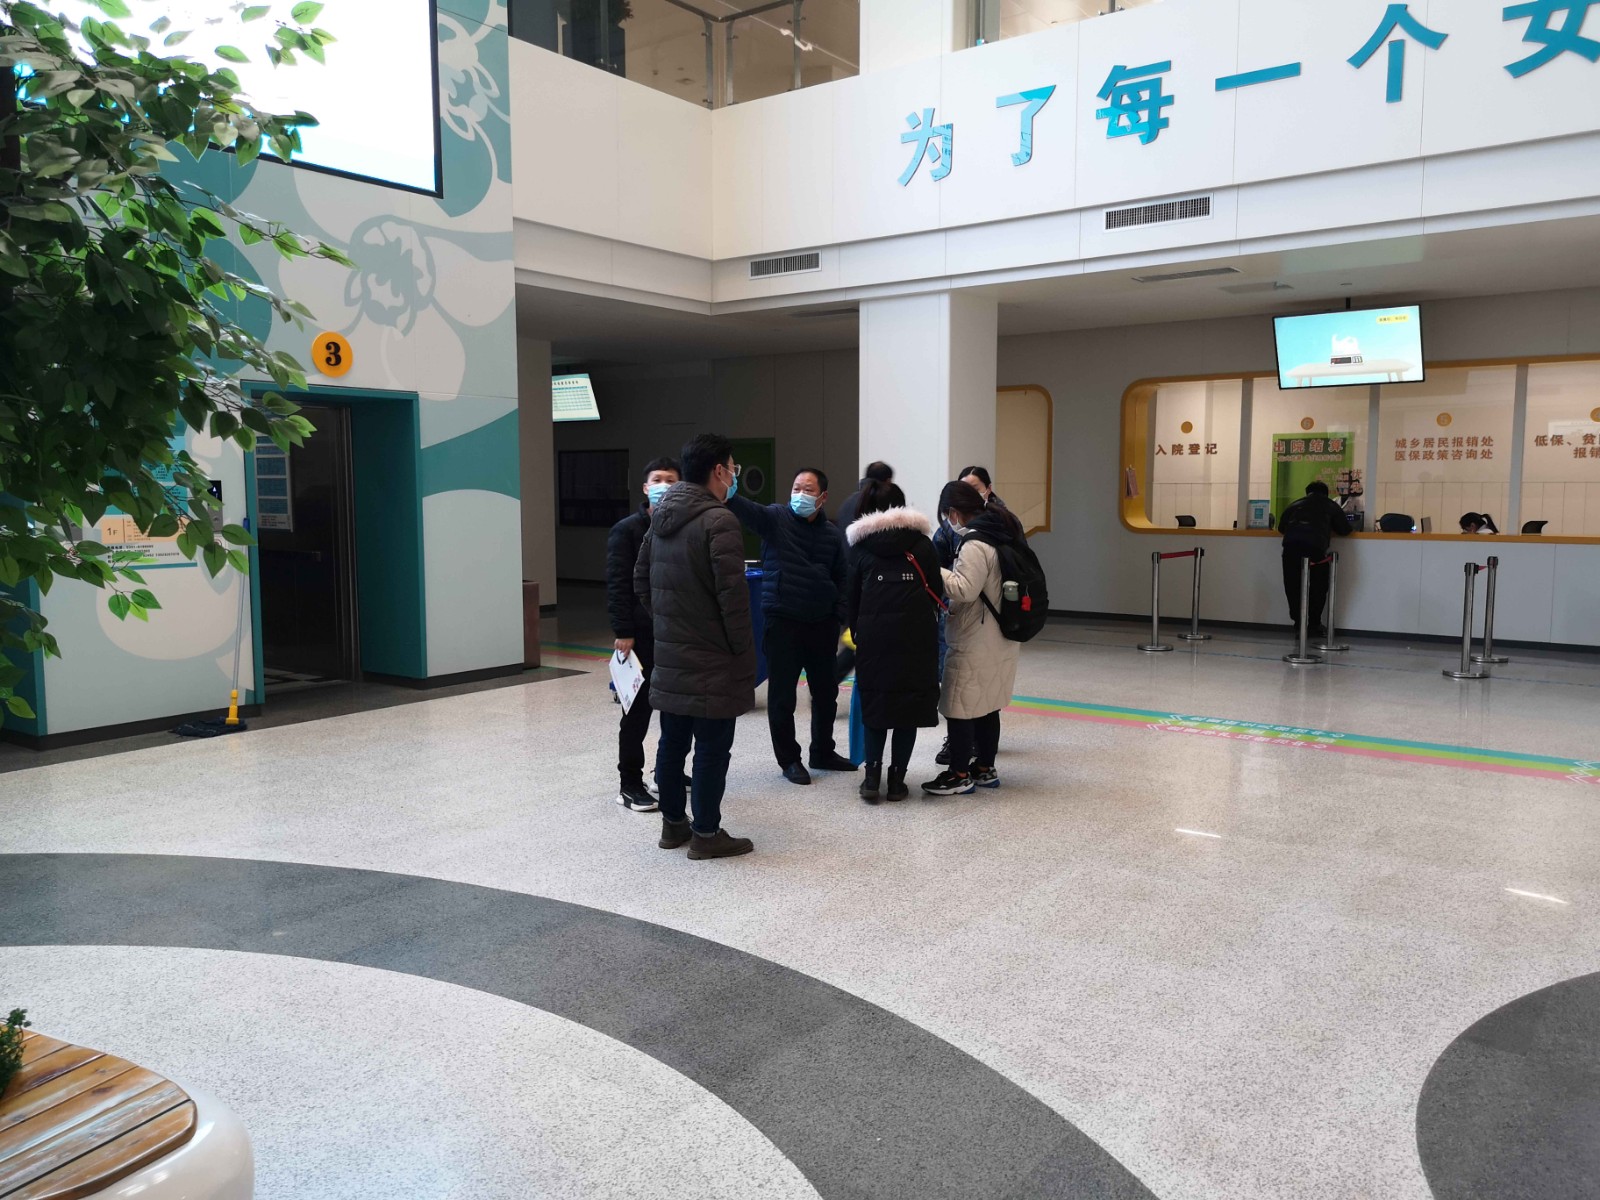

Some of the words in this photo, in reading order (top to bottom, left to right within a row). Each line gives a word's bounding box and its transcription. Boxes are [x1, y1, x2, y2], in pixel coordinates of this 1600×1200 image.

[325, 341, 342, 367] 3
[1155, 443, 1218, 456] 入院登记
[1273, 438, 1344, 454] 出院结算
[1395, 436, 1494, 449] 城乡居民报销处
[1394, 448, 1493, 462] 医保政策咨询处
